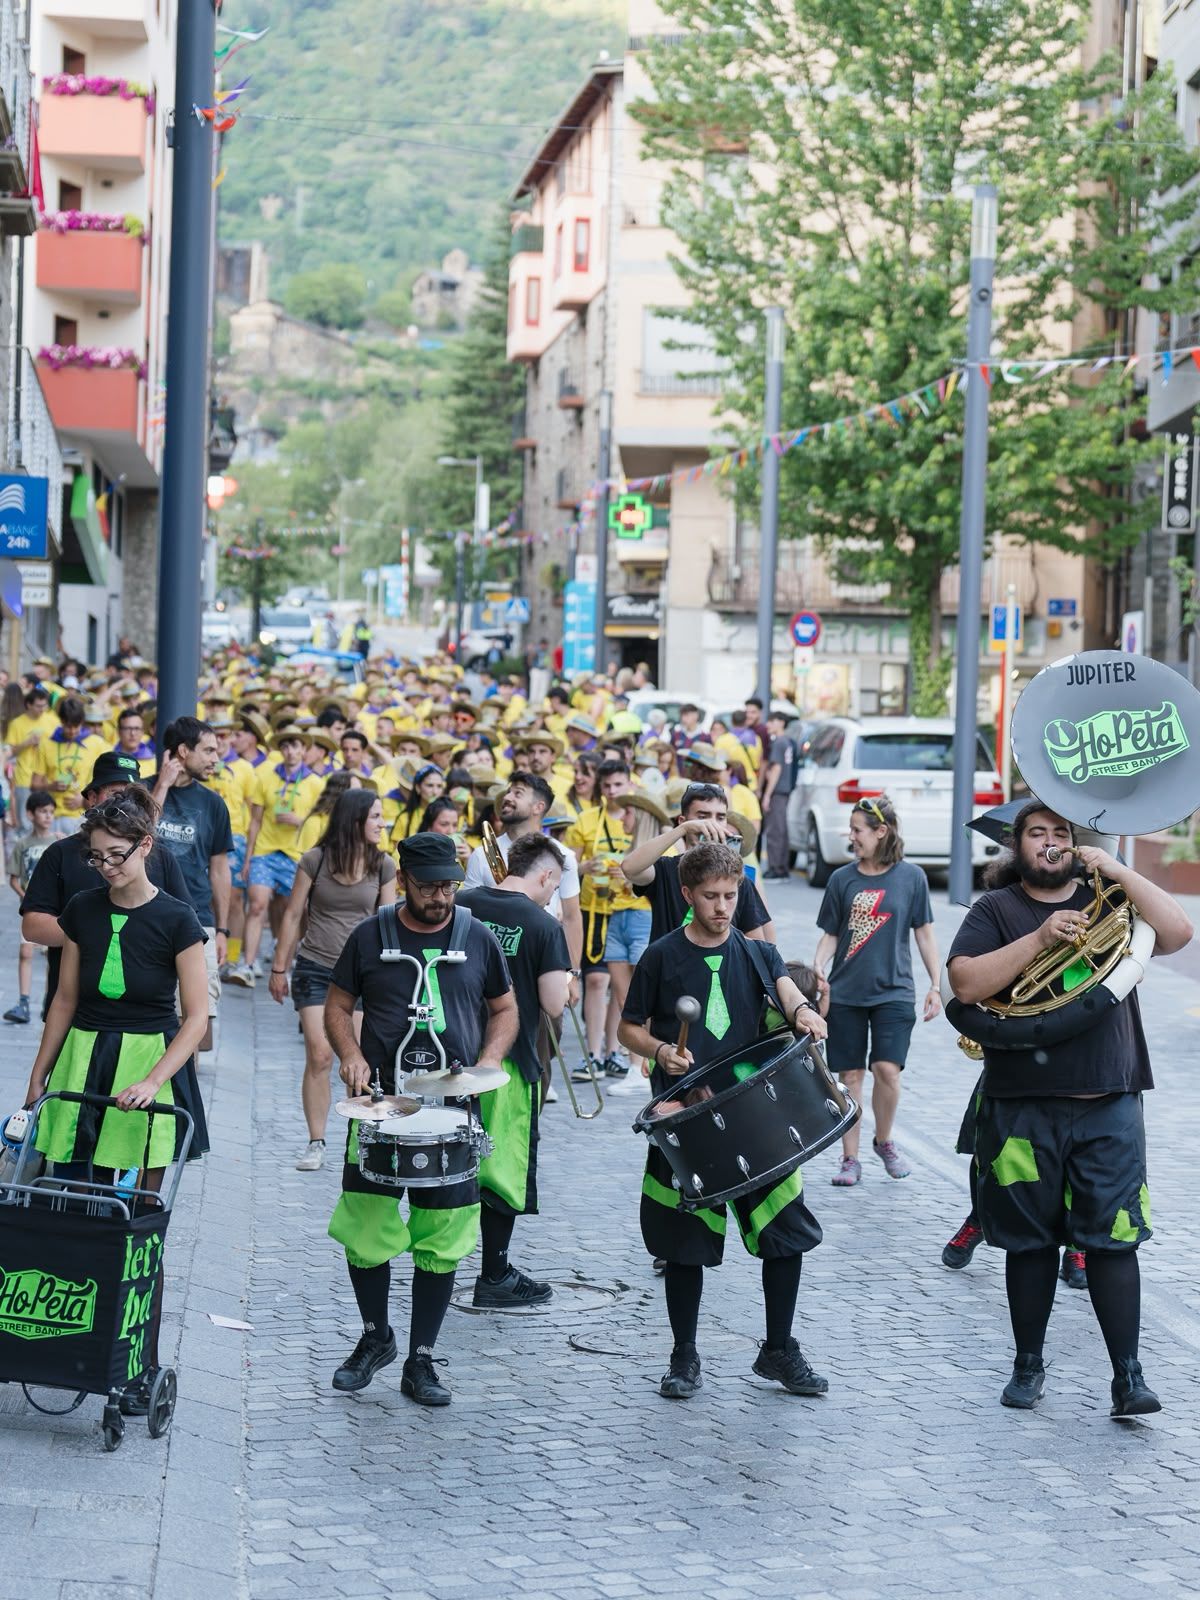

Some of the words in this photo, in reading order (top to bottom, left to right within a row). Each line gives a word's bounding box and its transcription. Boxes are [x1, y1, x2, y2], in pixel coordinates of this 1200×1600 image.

[7, 535, 31, 549] 24h
[1067, 661, 1136, 686] JUPITER
[1062, 705, 1176, 781] HoPeta
[1091, 762, 1129, 776] STREET
[1131, 756, 1161, 768] BAND
[415, 1053, 426, 1063] M
[0, 1275, 94, 1321] HoPeta
[35, 1325, 62, 1336] BAND
